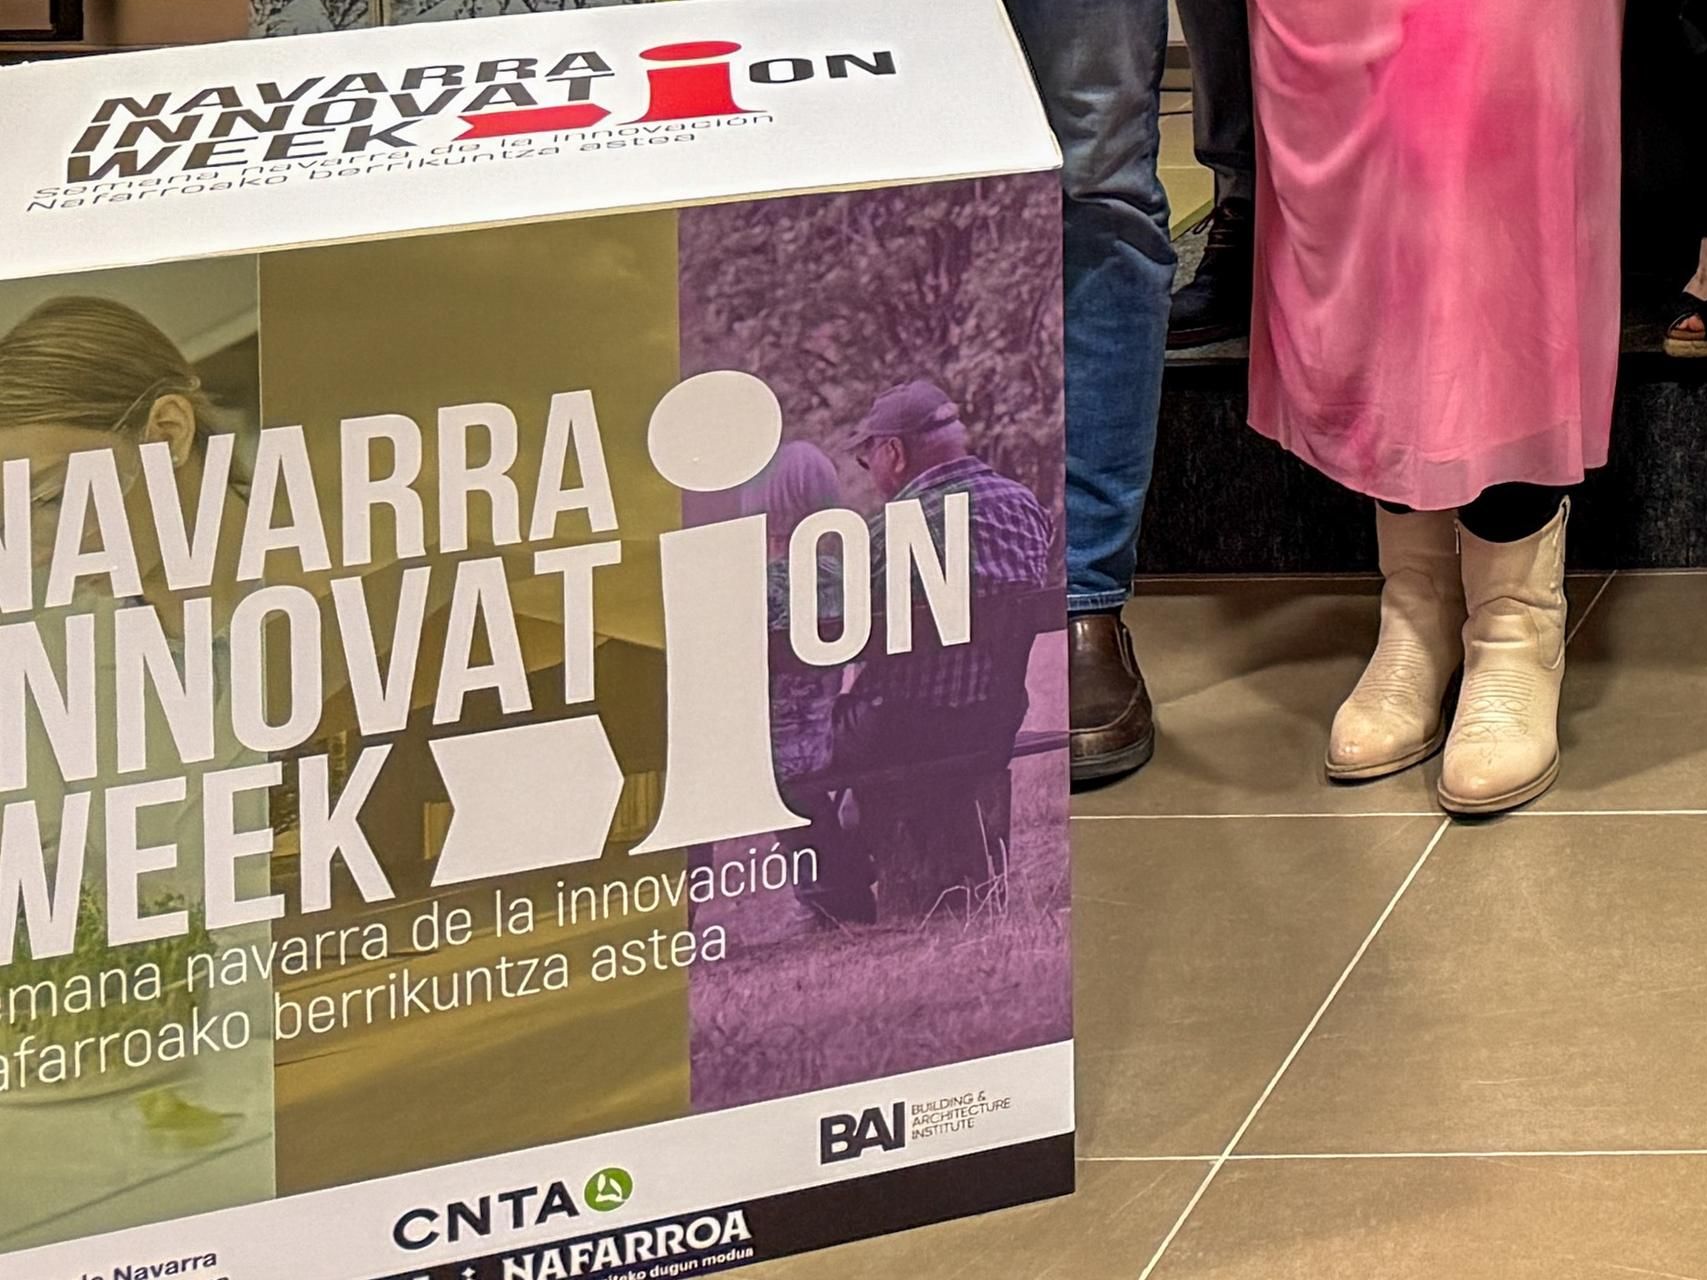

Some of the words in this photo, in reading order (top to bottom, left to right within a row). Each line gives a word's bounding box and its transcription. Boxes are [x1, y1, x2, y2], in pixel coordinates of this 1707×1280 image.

[91, 50, 613, 124] NAVARRA
[27, 174, 289, 212] Nafarroako
[309, 145, 561, 180] berrikuntza
[579, 133, 696, 152] astea
[34, 170, 220, 199] Semana
[241, 148, 411, 176] navarra
[430, 141, 480, 157] de
[500, 131, 534, 148] la
[554, 114, 774, 142] innovación
[67, 120, 422, 184] WEEK
[0, 962, 161, 1025] mana
[187, 923, 389, 994] navarra
[412, 900, 472, 954] de
[493, 888, 537, 936] la
[556, 842, 818, 929] innovación
[0, 1010, 252, 1092] farroako
[274, 948, 570, 1041] berrikuntza
[590, 923, 728, 984] astea
[820, 1100, 906, 1165] BAI
[911, 1092, 975, 1116] BUILDING
[977, 1090, 987, 1102] &
[911, 1118, 976, 1141] INSTITUTE
[912, 1097, 1012, 1128] ARCHITECTURE
[392, 1181, 580, 1251] CNTA
[501, 1210, 753, 1280] NAFARROA
[113, 1251, 218, 1280] Navarra
[649, 1258, 698, 1278] dugun
[701, 1247, 754, 1267] modua
